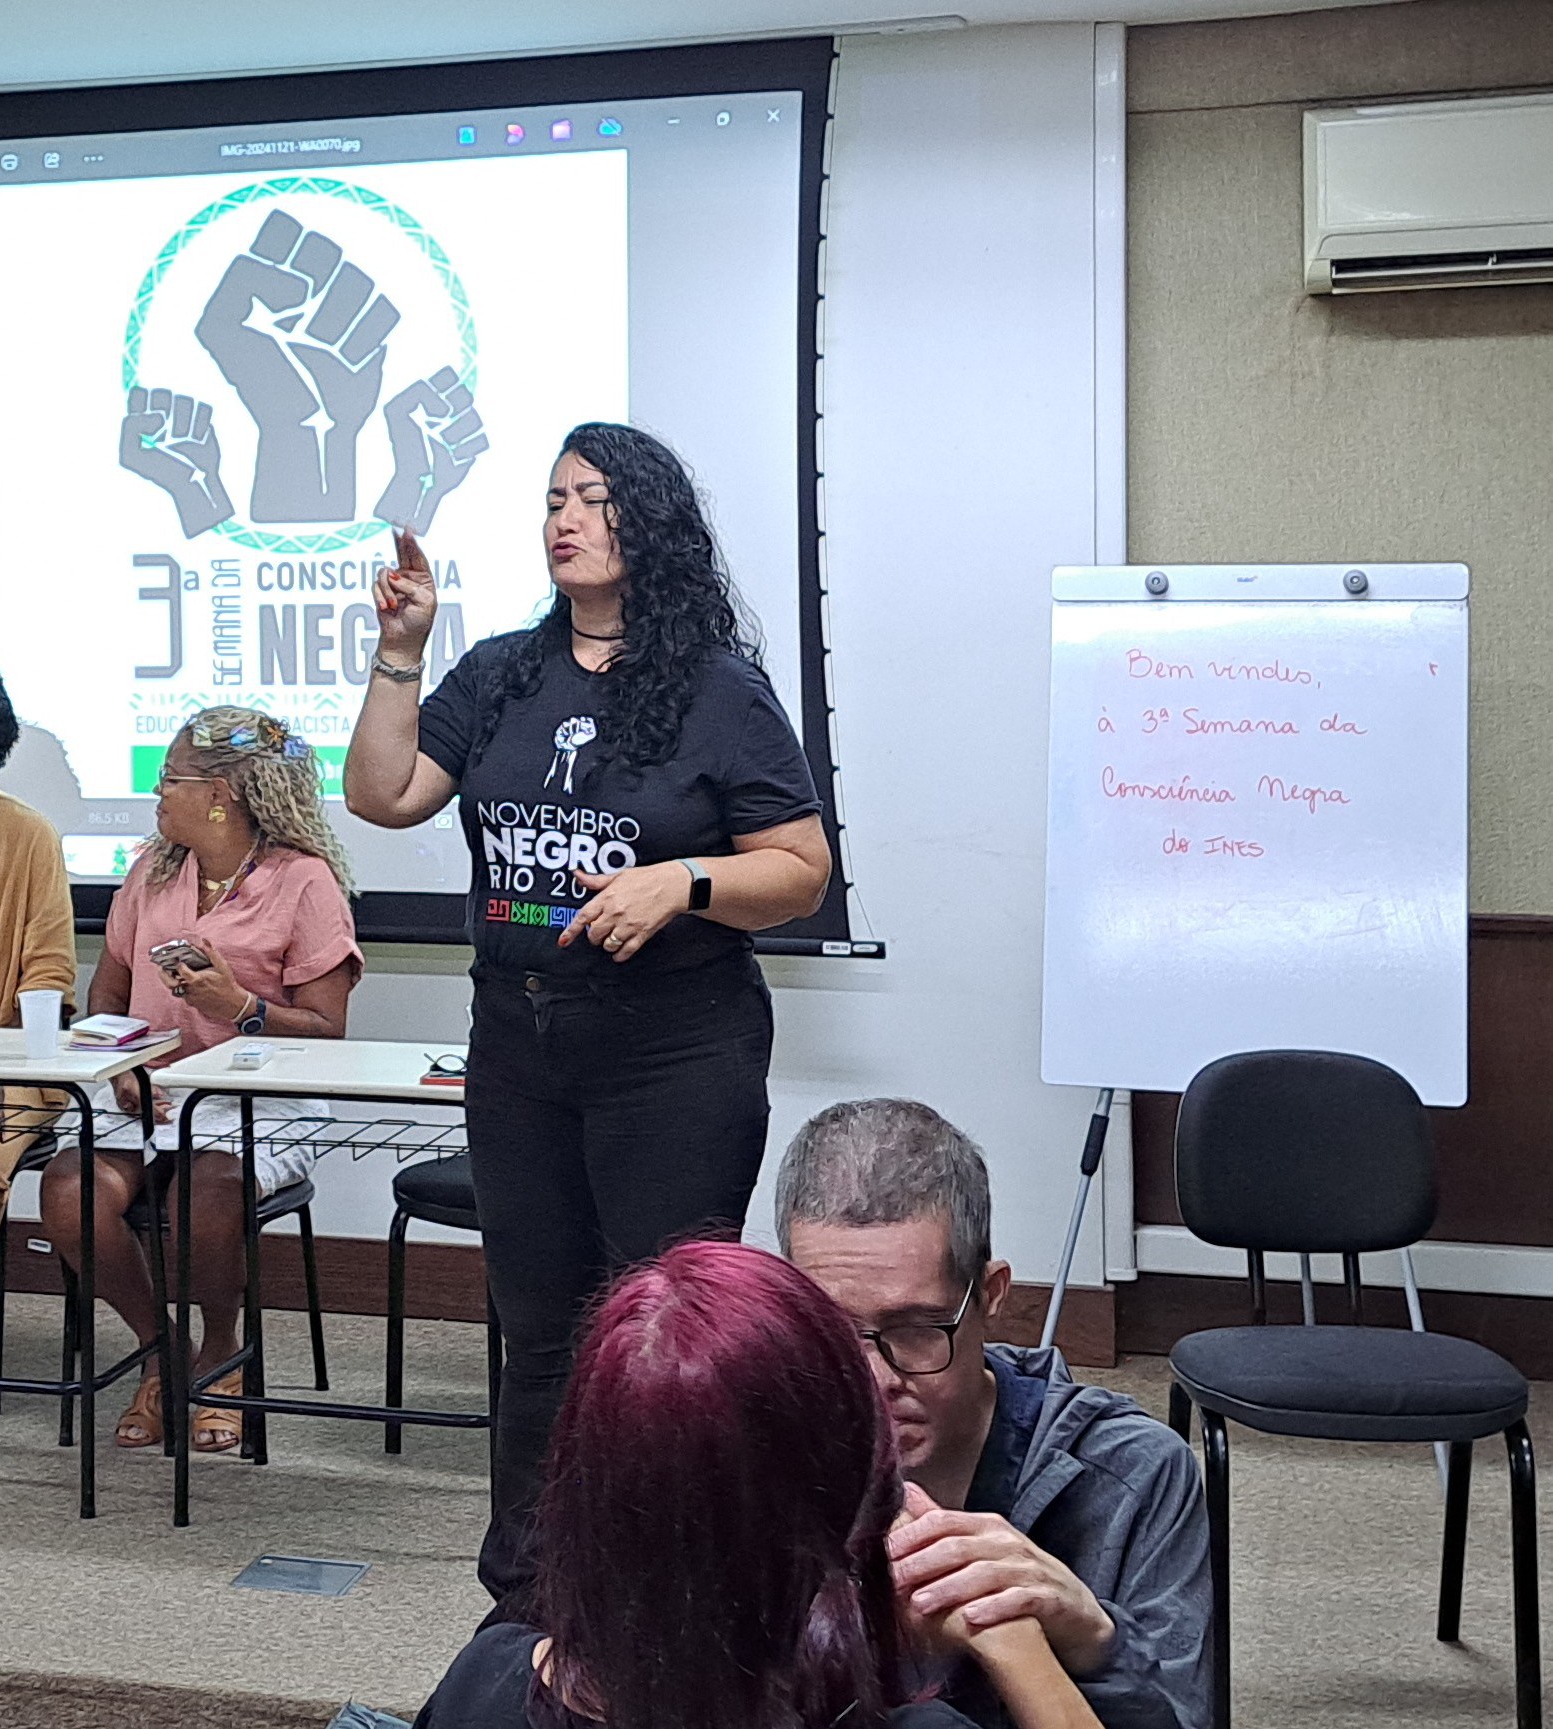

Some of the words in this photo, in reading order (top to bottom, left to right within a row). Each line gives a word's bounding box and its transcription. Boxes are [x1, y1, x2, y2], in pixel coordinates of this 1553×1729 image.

[211, 559, 241, 587] DA
[212, 595, 242, 686] SEMANA
[259, 603, 467, 686] NEGA
[1126, 648, 1194, 678] Bem
[1097, 706, 1115, 733] à
[1183, 708, 1300, 734] Semana
[1319, 713, 1368, 735] da
[1102, 766, 1236, 801] Consciência
[1258, 775, 1351, 815] Negra
[477, 801, 640, 842] NOVEMBRO
[483, 826, 637, 875] NEGRO
[1204, 835, 1265, 858] INES
[488, 864, 535, 893] RIO
